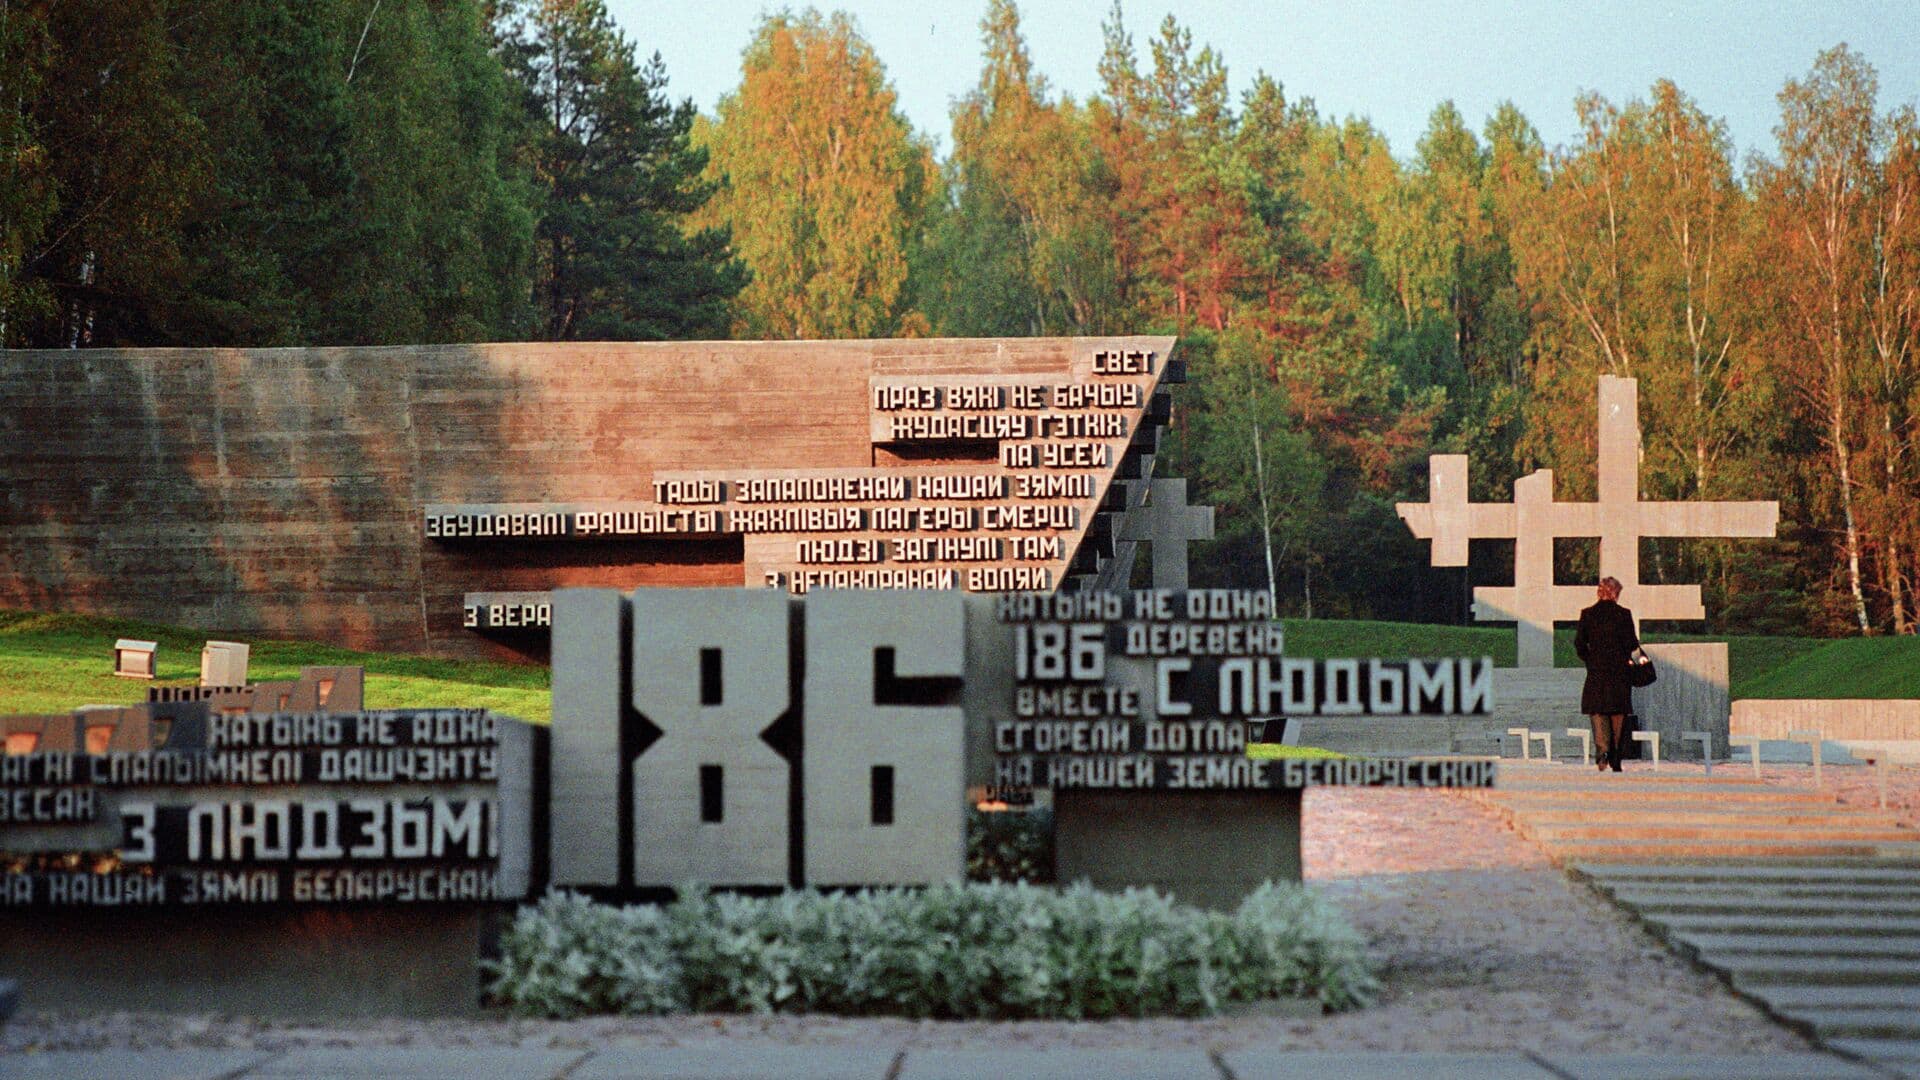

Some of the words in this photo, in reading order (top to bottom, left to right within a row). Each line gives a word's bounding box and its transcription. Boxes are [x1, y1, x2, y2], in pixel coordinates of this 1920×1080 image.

[1092, 351, 1153, 373] СВЕТ
[874, 386, 935, 409] ПРАЗ
[947, 386, 999, 408] ВЯКІ
[1011, 385, 1041, 407] НЕ
[1037, 414, 1122, 436] ГЭТКІХ
[1002, 445, 1033, 467] ПА
[653, 480, 720, 502] ТАДЫ
[1015, 474, 1090, 497] ЗЯМЛІ
[426, 512, 566, 536] ЗБУДАВАЛІ
[575, 510, 716, 534] ФАШЫСТЫ
[730, 507, 861, 531] ЖАХЛІВЫЯ
[872, 506, 972, 529] ЛАГЕРЫ
[983, 505, 1074, 528] СМЕРЦІ
[796, 539, 878, 562] ЛЮДЗІ
[892, 537, 998, 561] ЗАГІНУЛІ
[1009, 536, 1060, 559] ТАМ
[464, 605, 477, 627] З
[1135, 589, 1174, 619] НЕ
[1187, 589, 1270, 619] ОДНА
[1016, 624, 1105, 680] 186
[1126, 622, 1283, 655] ДЕРЕВЕНЬ
[1016, 686, 1138, 716] ВМЕСТЕ
[1157, 657, 1191, 715] С
[1219, 656, 1493, 715] ЛЮДЬМИ
[209, 713, 341, 745] ХАТЫНЬ
[356, 712, 397, 743] НЕ
[412, 711, 497, 743] АДНА
[551, 587, 965, 887] 186
[995, 720, 1129, 751] СГОРЕЛИ
[1145, 720, 1245, 751] ДОТЛА
[318, 748, 497, 781] ДАШЧЭНТУ
[995, 756, 1032, 786] НА
[1168, 755, 1269, 787] ЗЕМЛЕ
[119, 801, 155, 862] З
[188, 799, 498, 861] ЛЮДЗЬМІ
[181, 871, 278, 903] ЗЯМЛІ
